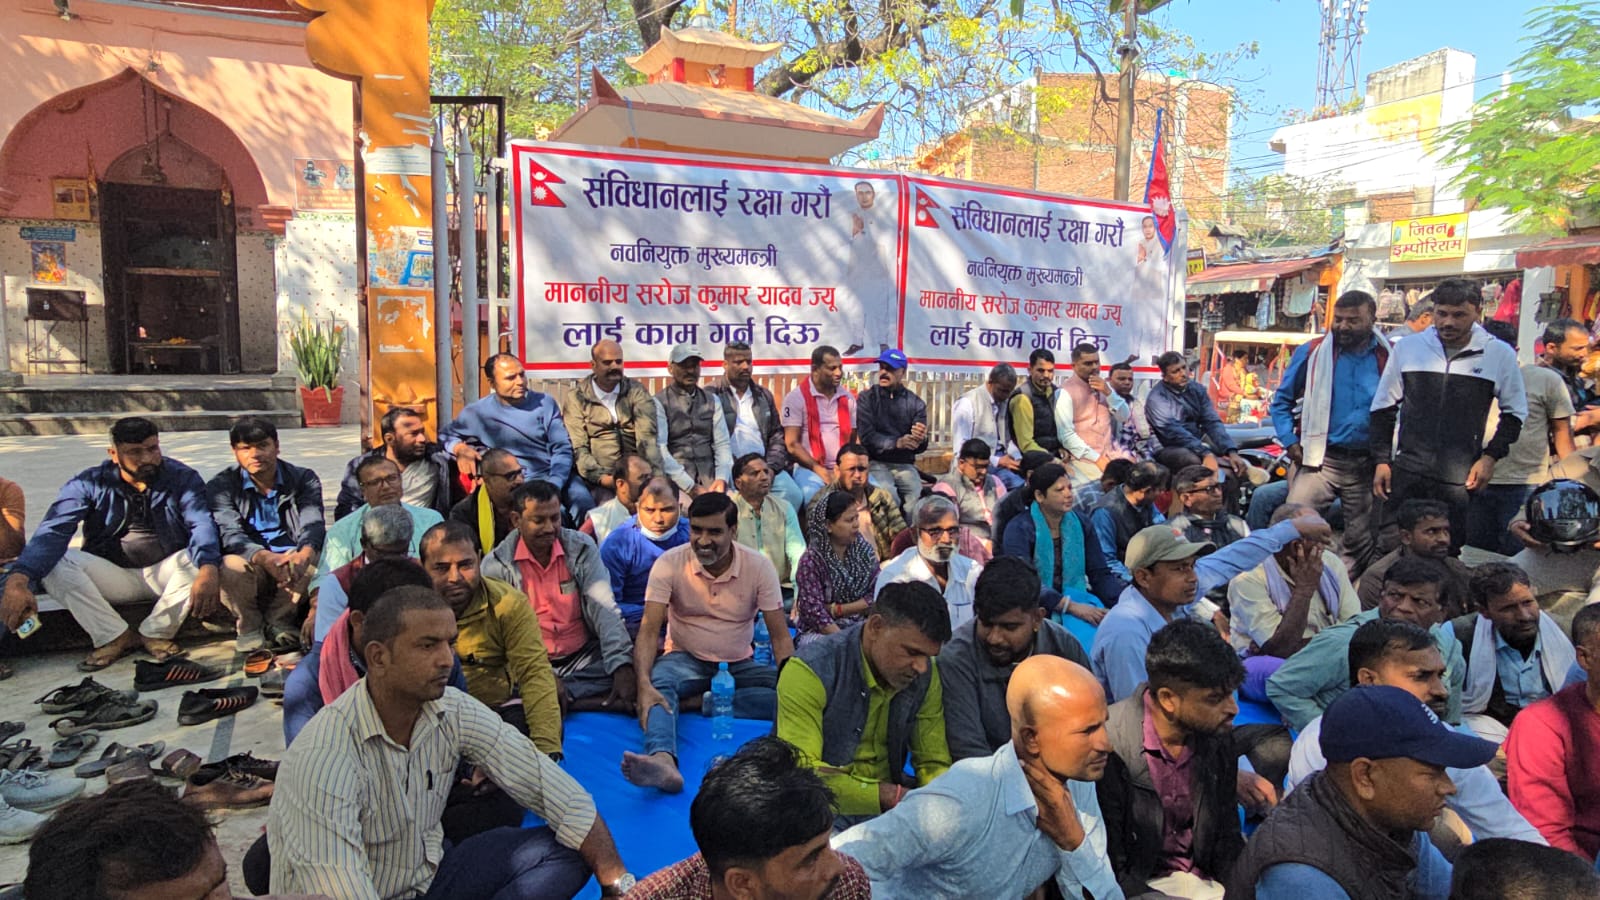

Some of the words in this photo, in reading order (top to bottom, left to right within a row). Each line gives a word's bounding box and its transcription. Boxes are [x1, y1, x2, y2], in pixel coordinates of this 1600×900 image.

[583, 168, 730, 218] संविधानलाई
[738, 187, 783, 218] रक्षा
[950, 199, 1053, 243] संविधानलाई
[1057, 218, 1090, 245] रक्षा
[610, 237, 691, 270] नवनियुक्त
[966, 256, 1023, 285] नवनियुक्त
[544, 276, 630, 305] माननीय
[636, 277, 692, 306] सरोज
[697, 285, 751, 312] कुमार
[757, 286, 803, 307] यादव
[808, 287, 838, 312] ज्यू
[919, 287, 977, 311] माननीय
[981, 290, 1021, 315] सरोज
[1024, 299, 1062, 321] कुमार
[1065, 302, 1098, 321] यादव
[1101, 304, 1123, 326] ज्यू
[563, 316, 625, 347] लाई
[635, 323, 700, 345] काम
[708, 316, 756, 345] गर्न
[765, 315, 823, 346] दिऊ
[929, 321, 973, 350] लाई
[978, 328, 1025, 350] काम
[1031, 327, 1063, 351] गर्न
[784, 406, 790, 417] 3
